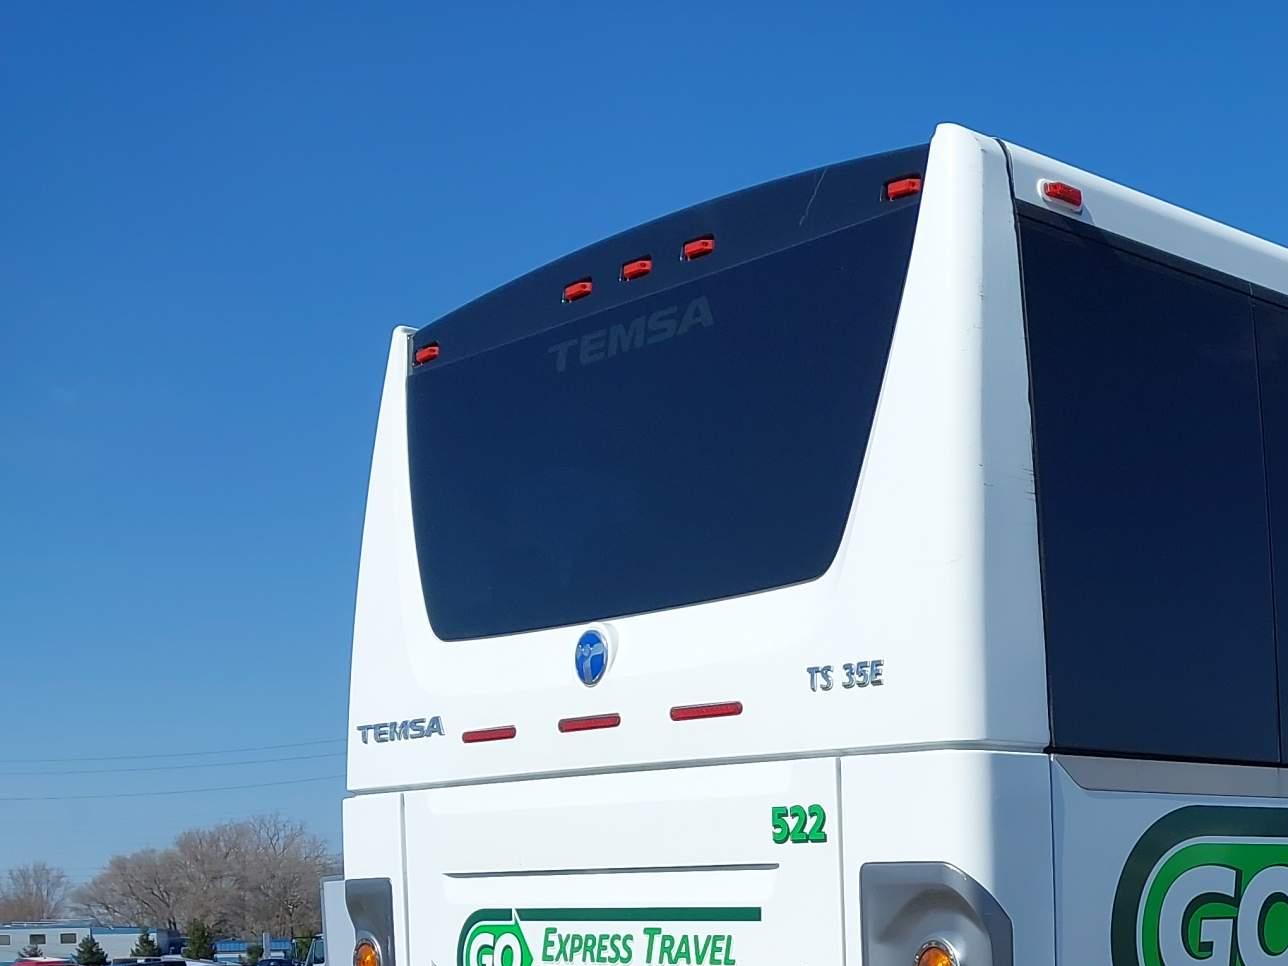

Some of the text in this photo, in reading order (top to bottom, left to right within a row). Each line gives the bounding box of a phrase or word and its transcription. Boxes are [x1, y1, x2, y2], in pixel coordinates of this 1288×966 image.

[547, 295, 715, 374] TEMSA
[806, 658, 885, 692] TS 35E
[356, 715, 446, 745] TEMSA
[771, 804, 828, 845] 522
